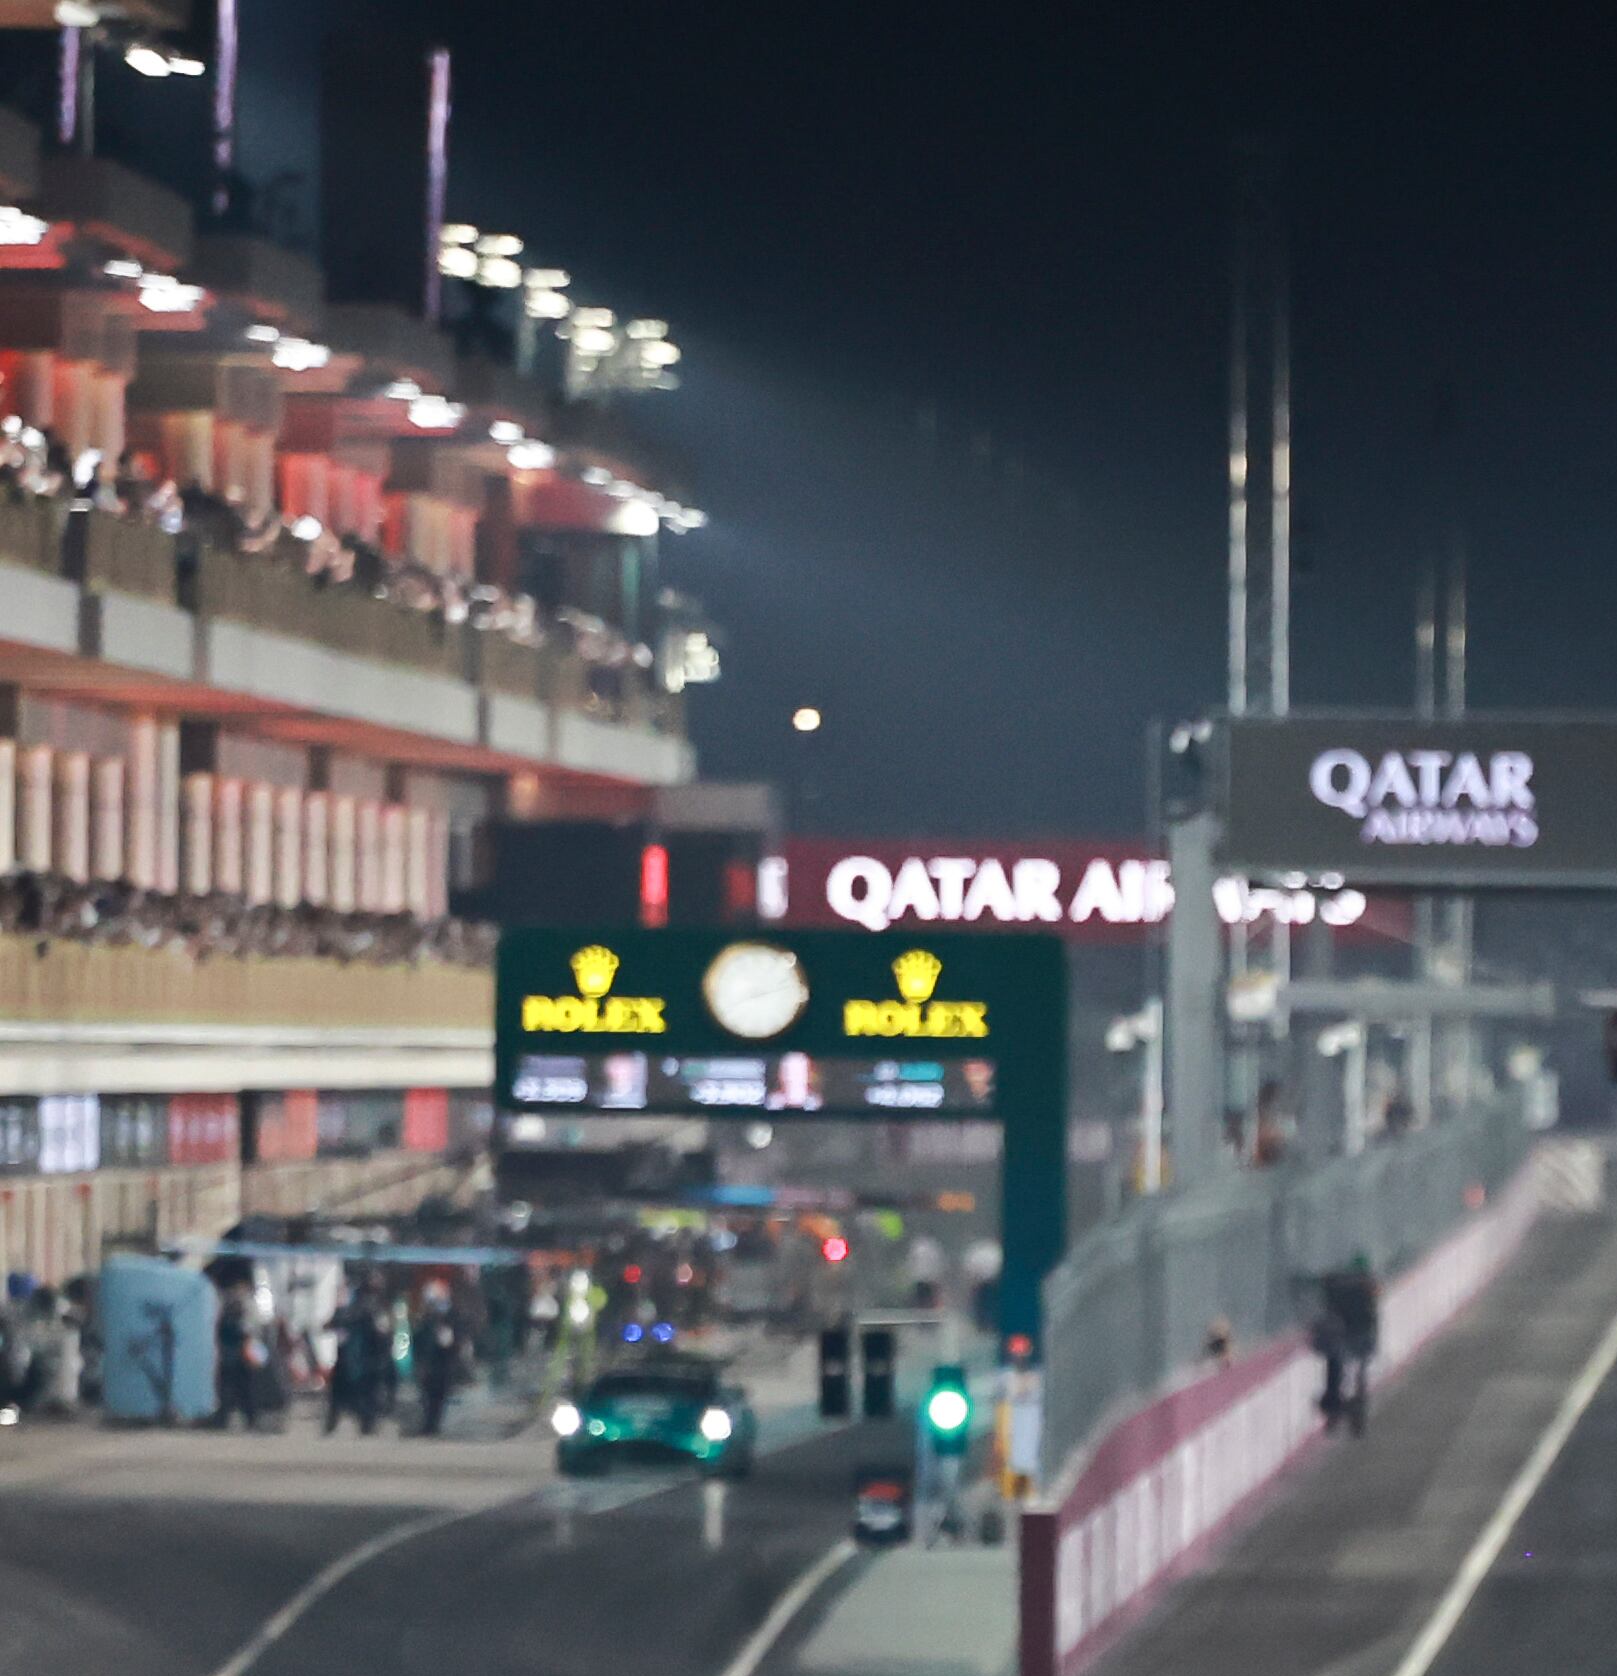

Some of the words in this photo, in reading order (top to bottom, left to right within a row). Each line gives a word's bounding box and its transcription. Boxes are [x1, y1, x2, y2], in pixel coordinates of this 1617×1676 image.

[1309, 749, 1535, 819] QATAR
[1360, 808, 1539, 848] AIRWAYS
[826, 855, 1063, 931] QATAR
[522, 995, 667, 1034] ROLEX
[843, 1000, 990, 1038] ROLEX
